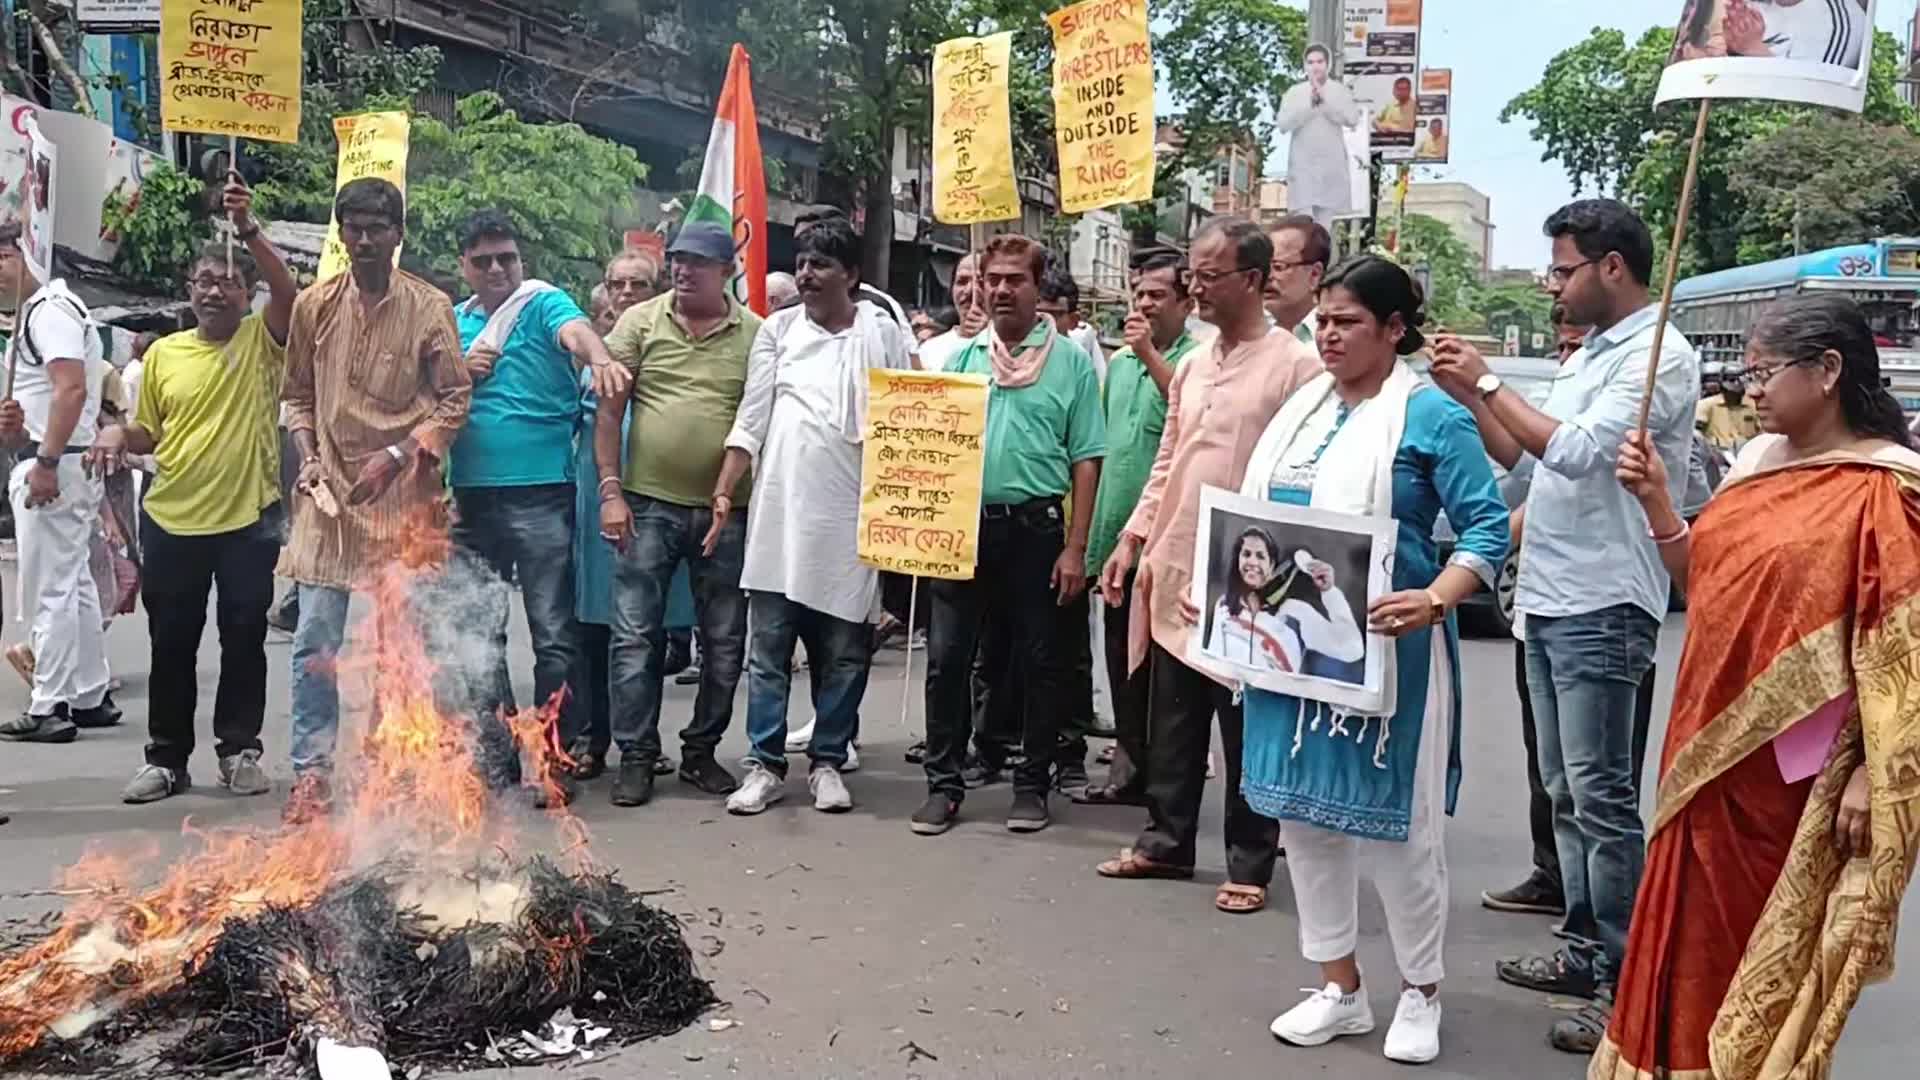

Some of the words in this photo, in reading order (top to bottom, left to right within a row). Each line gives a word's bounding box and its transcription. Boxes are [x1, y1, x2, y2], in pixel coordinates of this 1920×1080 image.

[1059, 0, 1139, 37] SUPPORT
[1079, 29, 1110, 50] OUR
[1059, 41, 1149, 84] WRESTLERS
[1076, 74, 1125, 104] INSIDE
[1086, 102, 1115, 120] AND
[347, 128, 377, 149] FIGHT
[1063, 112, 1140, 144] OUTSIDE
[1087, 139, 1115, 160] THE
[886, 505, 944, 521] আপনি
